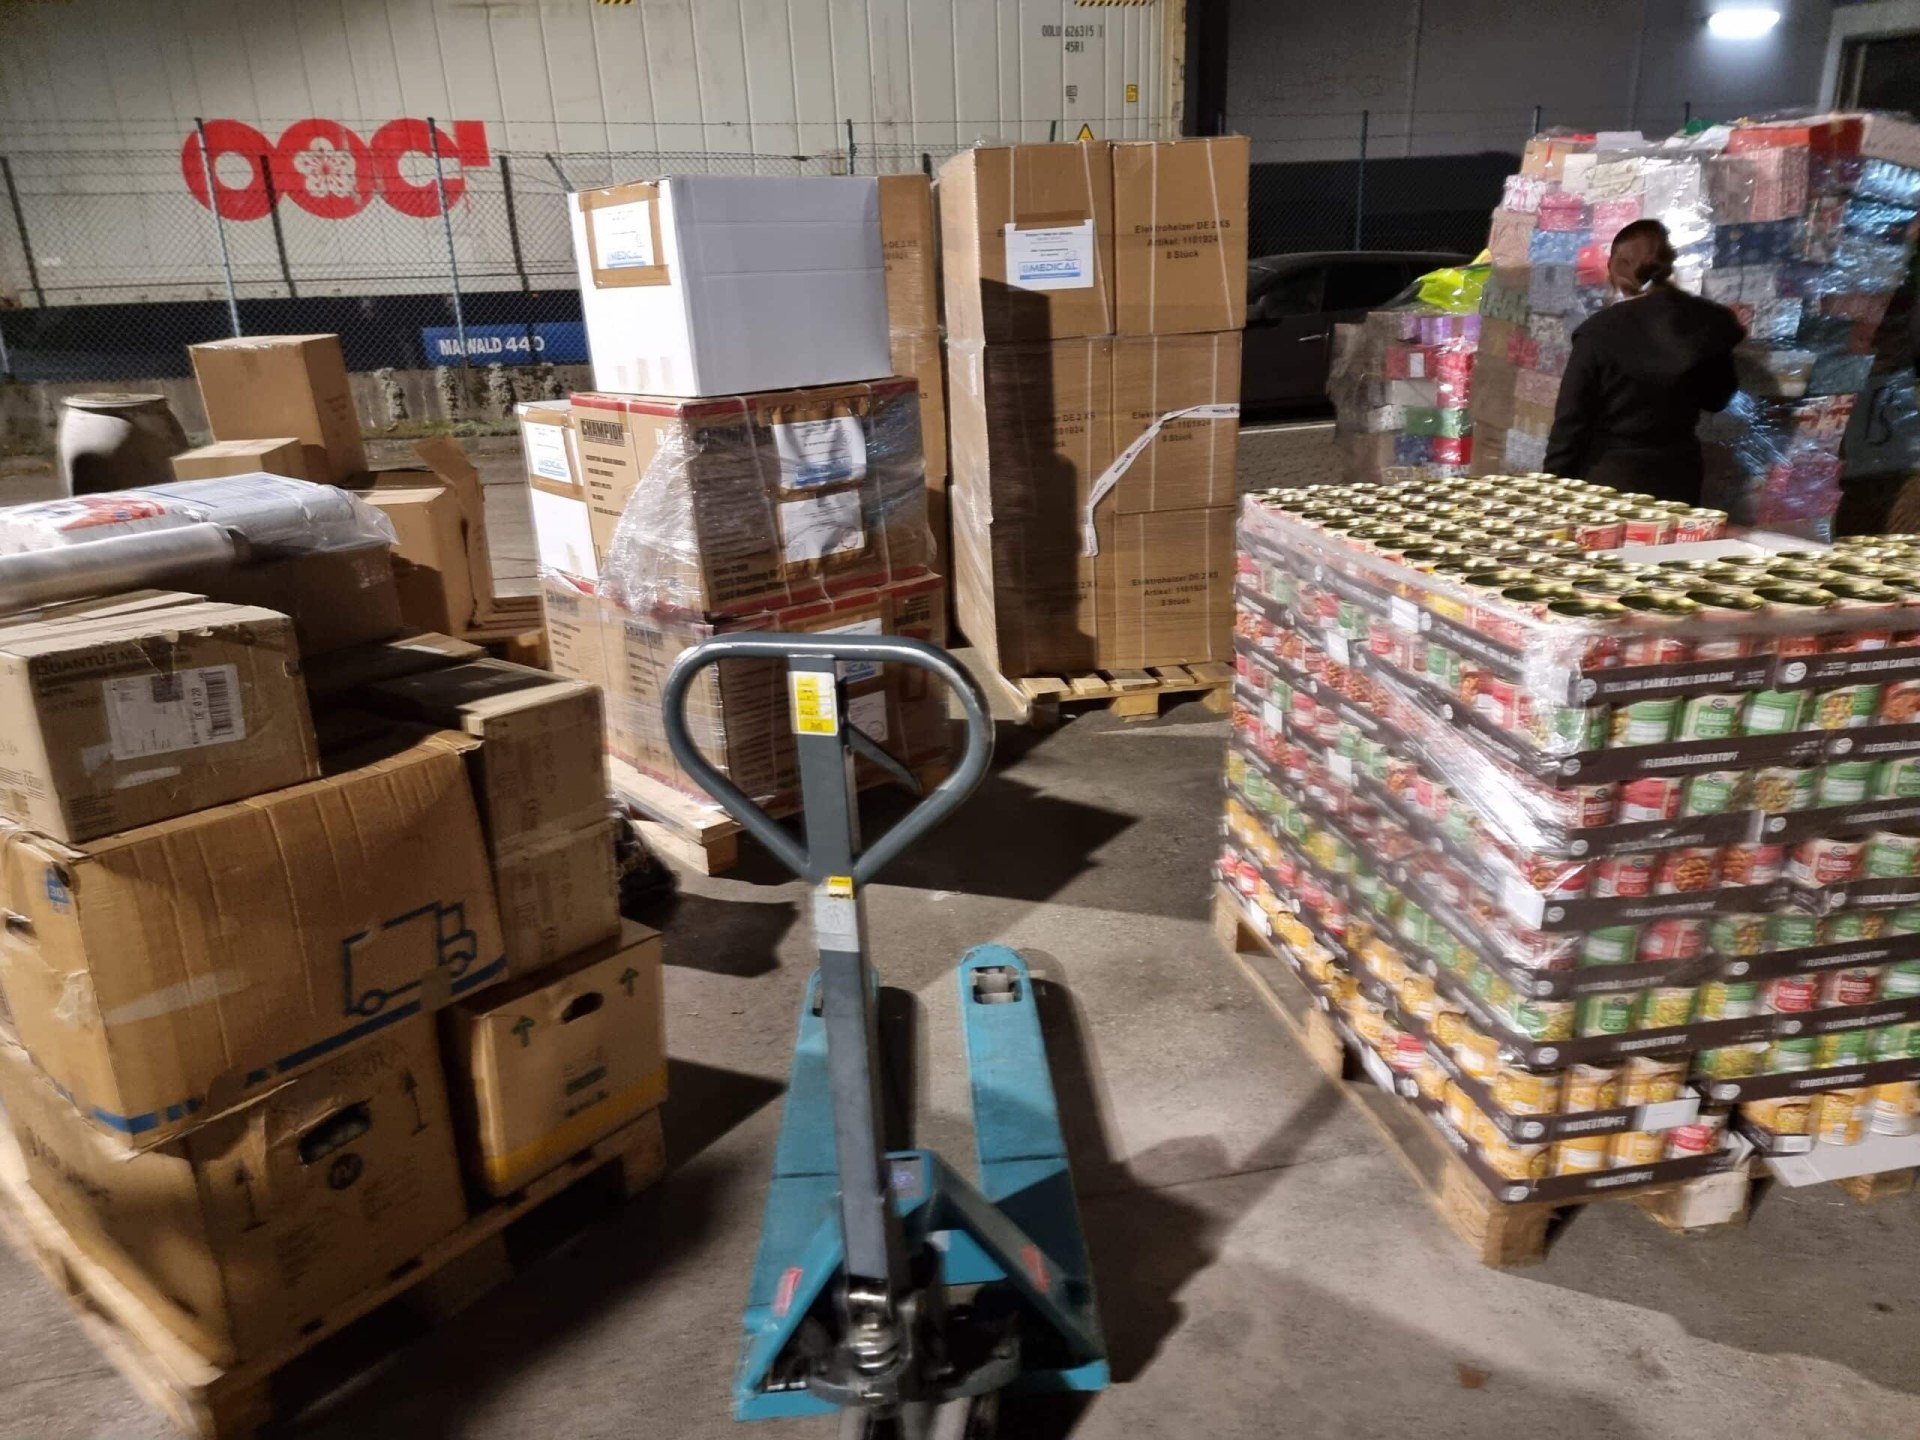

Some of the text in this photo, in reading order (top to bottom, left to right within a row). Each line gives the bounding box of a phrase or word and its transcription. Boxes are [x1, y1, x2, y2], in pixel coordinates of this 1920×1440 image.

[1065, 25, 1094, 37] 626315
[1197, 221, 1209, 230] DE
[1030, 262, 1079, 272] MEDICAL
[439, 336, 502, 356] MAWALD
[581, 419, 625, 441] CHAMPION
